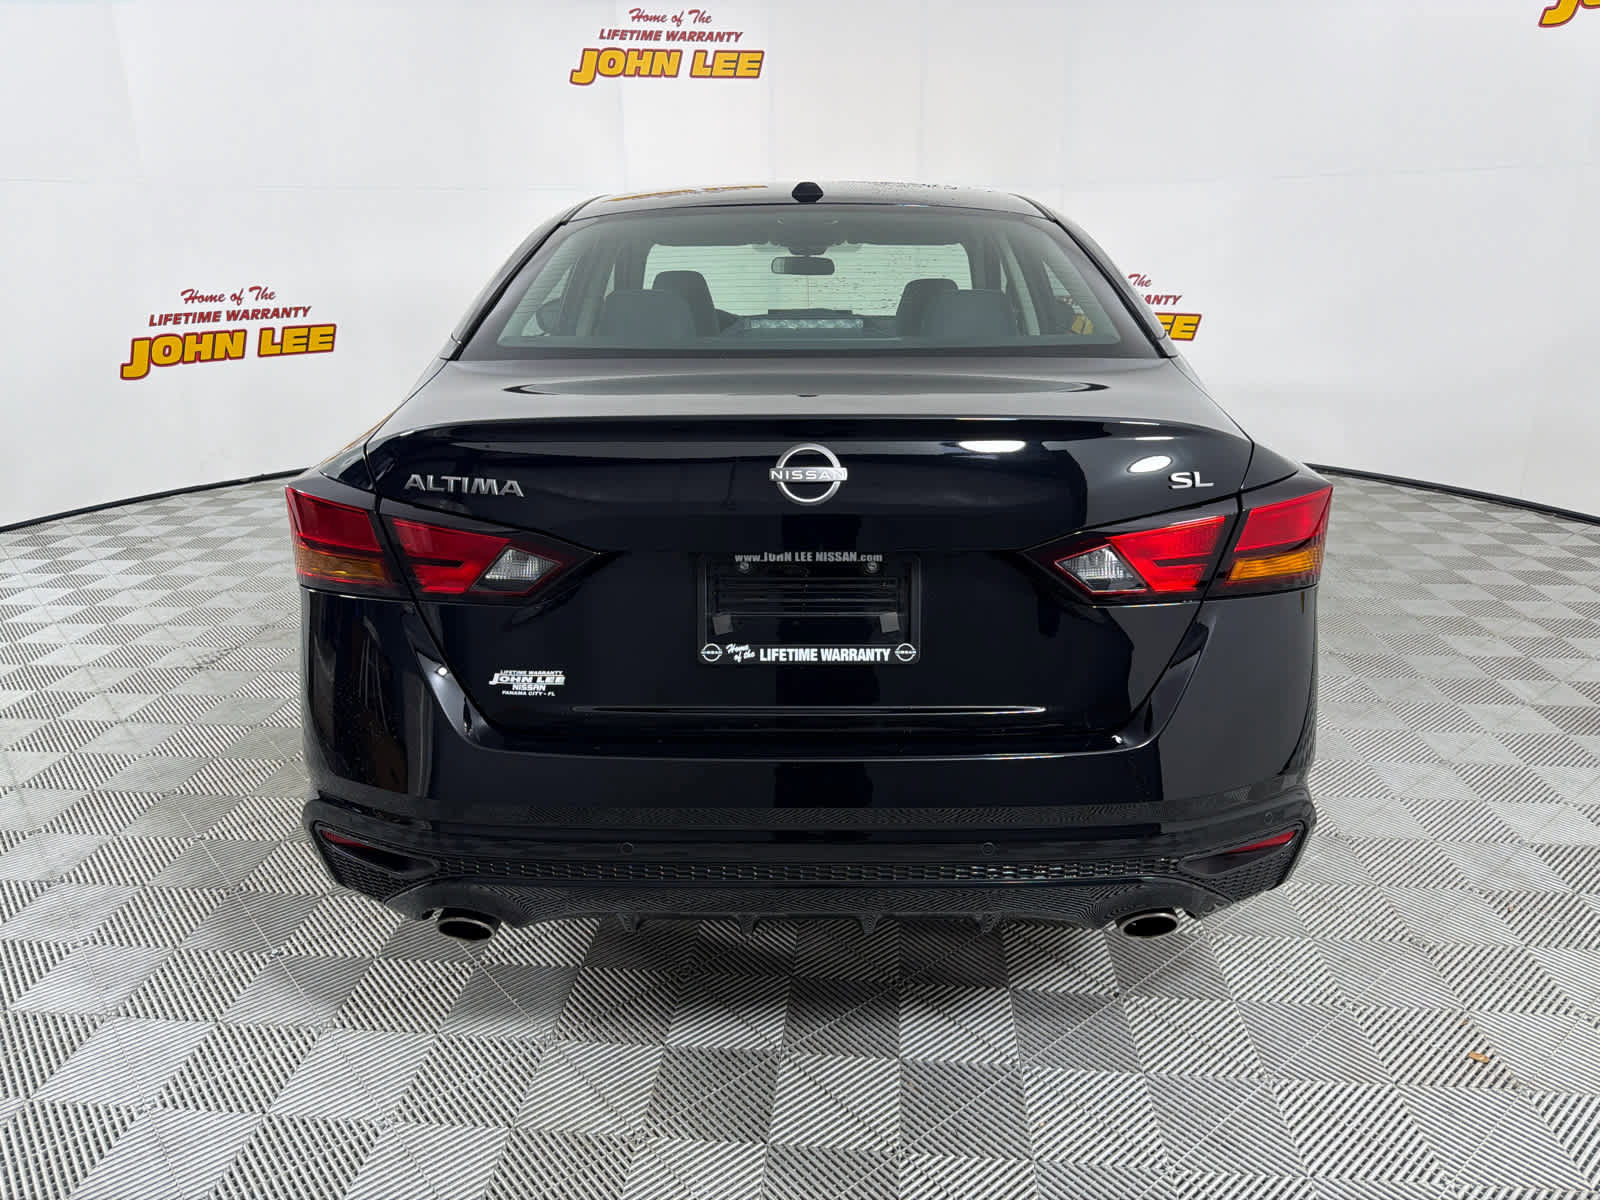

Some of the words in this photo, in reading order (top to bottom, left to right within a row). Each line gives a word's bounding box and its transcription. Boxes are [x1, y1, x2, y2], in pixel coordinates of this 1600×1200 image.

[628, 8, 668, 24] Home
[671, 10, 685, 27] of
[688, 9, 712, 24] The
[599, 29, 662, 41] LIFETIME
[666, 31, 743, 42] WARRANTY
[569, 47, 683, 86] JOHN
[689, 50, 764, 78] LEE
[1128, 273, 1152, 287] The
[180, 288, 225, 304] Home
[230, 288, 245, 306] of
[249, 286, 276, 301] The
[149, 310, 222, 326] LIFETIME
[226, 306, 312, 322] WARRANTY
[119, 329, 247, 380] JOHN
[257, 324, 337, 357] LEE
[770, 470, 847, 480] NISSAN
[1170, 471, 1214, 489] SL
[404, 473, 525, 497] ALTIMA
[795, 551, 813, 562] LEE
[815, 551, 883, 562] NISSAN.com
[759, 648, 819, 661] LIFETIME
[820, 648, 891, 661] WARRANTY
[489, 673, 533, 685] JOHN
[536, 676, 566, 685] LEE
